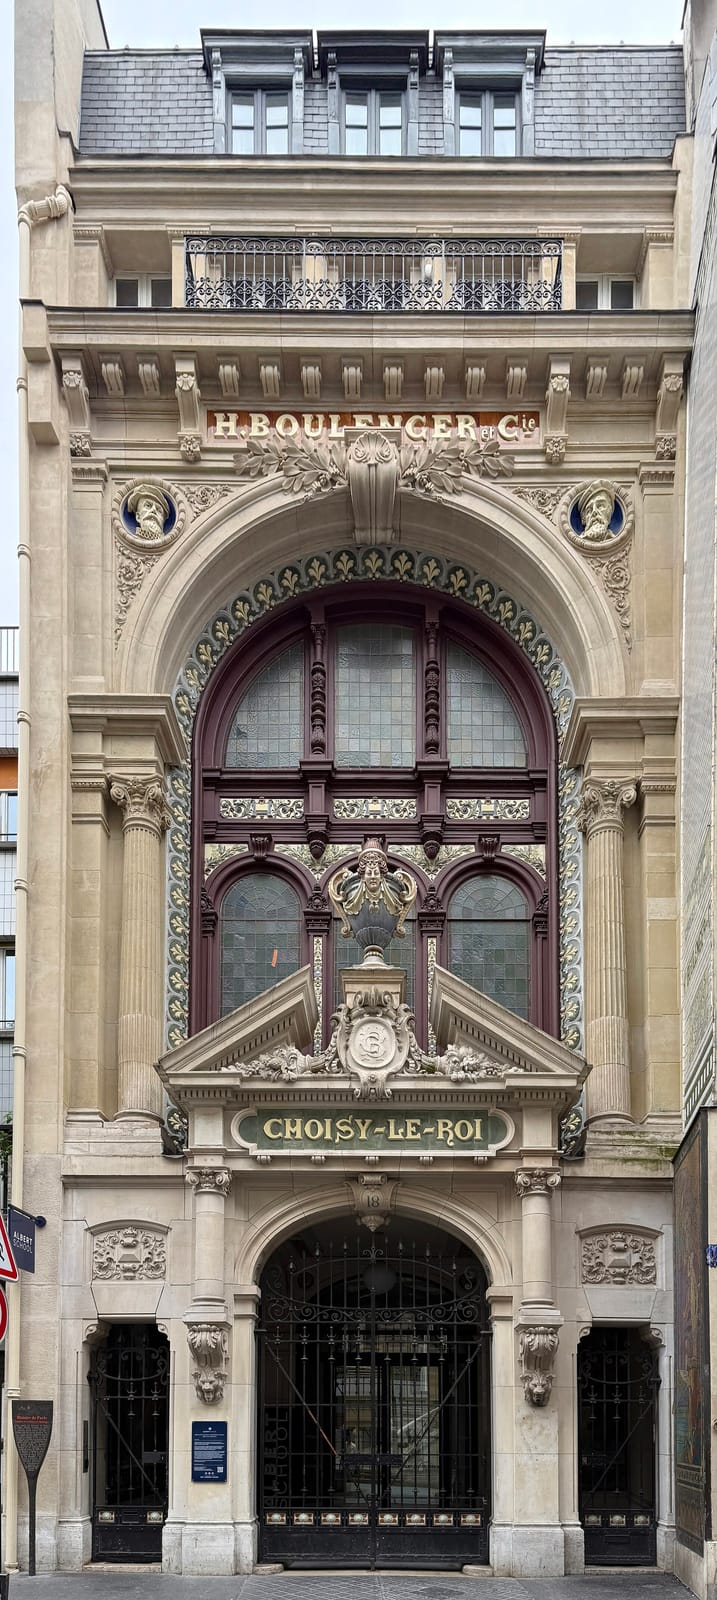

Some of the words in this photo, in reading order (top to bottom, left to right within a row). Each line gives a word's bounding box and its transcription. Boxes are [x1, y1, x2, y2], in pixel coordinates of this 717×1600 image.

[263, 1115, 483, 1146] CHOISY-LE-ROI
[367, 1195, 380, 1208] 18
[13, 1231, 32, 1246] ALBERT
[13, 1238, 33, 1254] SCHOOL
